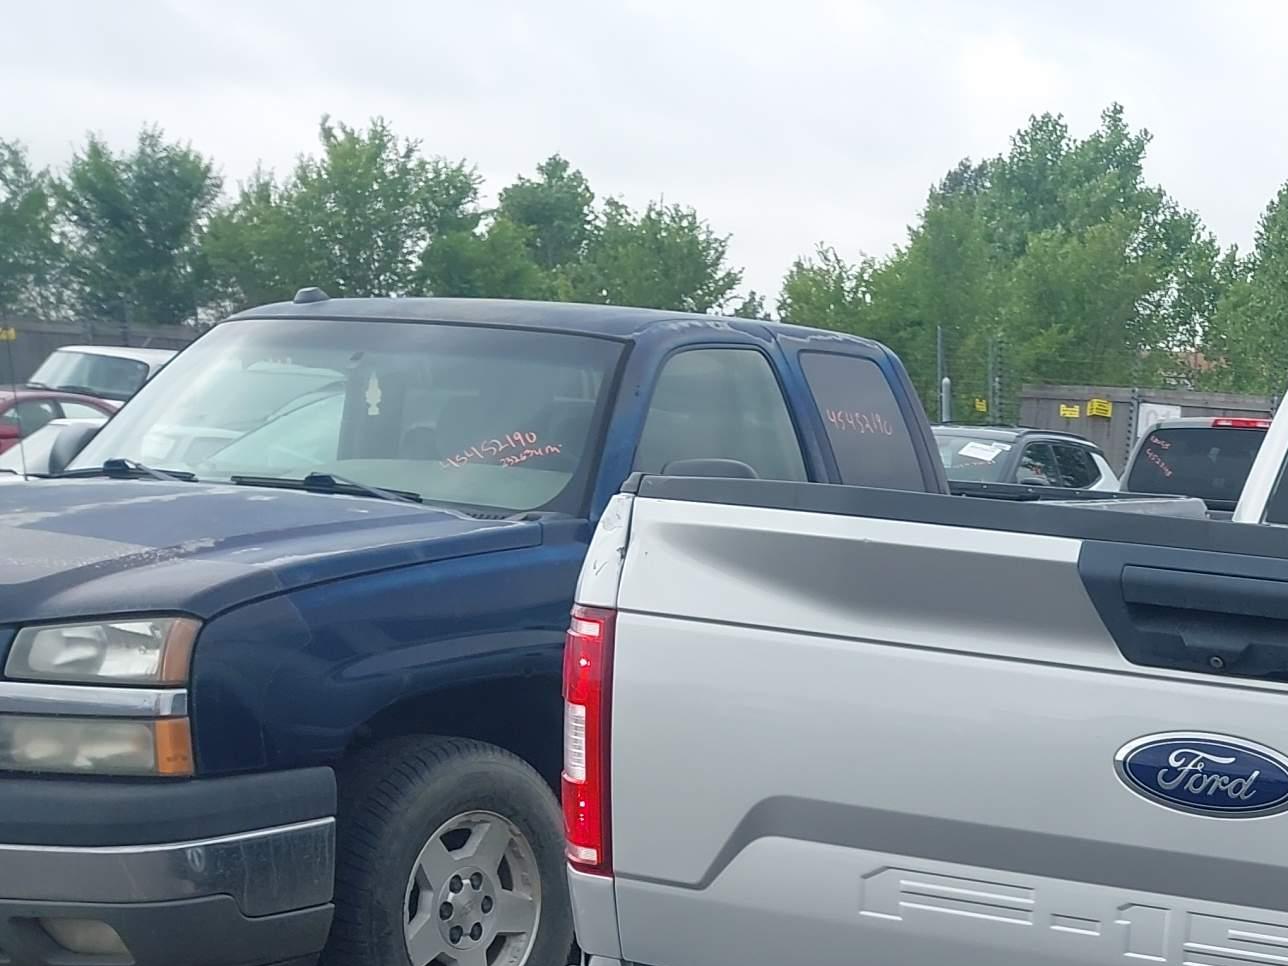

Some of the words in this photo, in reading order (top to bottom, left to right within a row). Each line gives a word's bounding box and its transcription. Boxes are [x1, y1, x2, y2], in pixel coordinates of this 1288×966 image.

[826, 408, 893, 436] 45452190
[439, 431, 538, 469] 45452190
[1156, 748, 1261, 801] Ford
